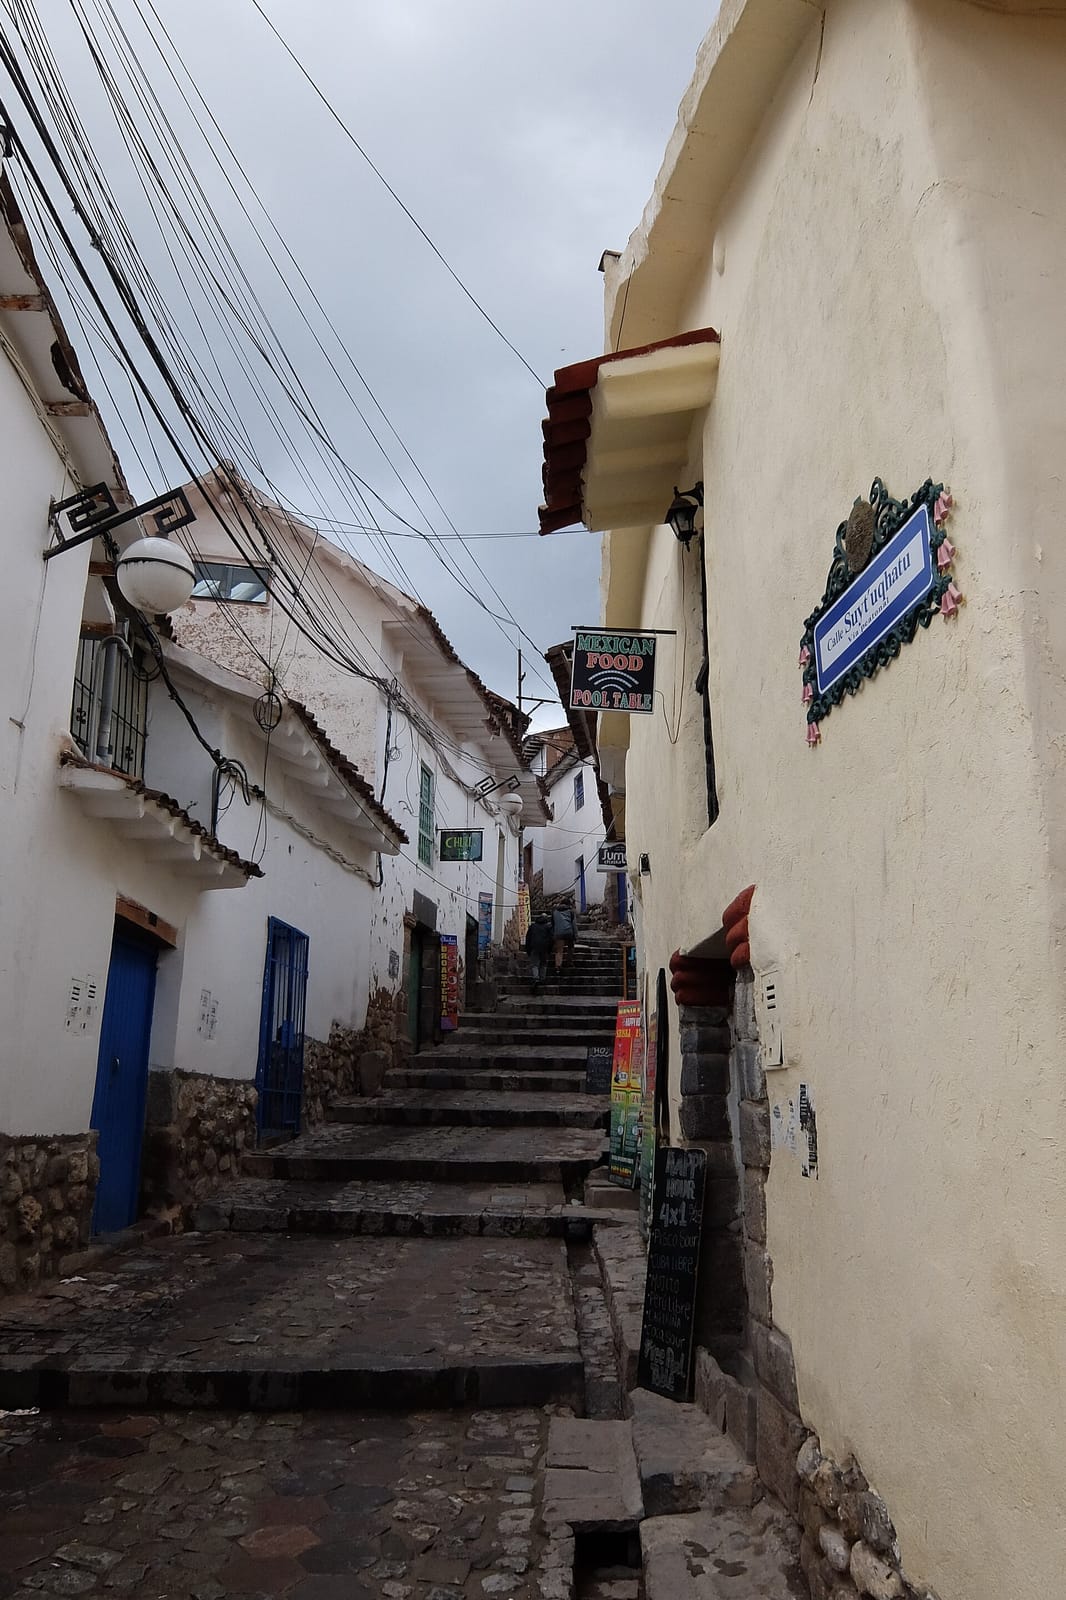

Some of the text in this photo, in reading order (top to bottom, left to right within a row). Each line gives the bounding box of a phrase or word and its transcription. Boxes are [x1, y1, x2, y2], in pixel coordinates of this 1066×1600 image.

[827, 552, 911, 651] Calle Suyt'uqhatu
[861, 597, 889, 632] peatonal
[577, 635, 654, 655] MEXICAN
[586, 653, 644, 671] FOOD
[573, 689, 652, 710] POOL TABLE
[665, 1179, 696, 1200] HOUR
